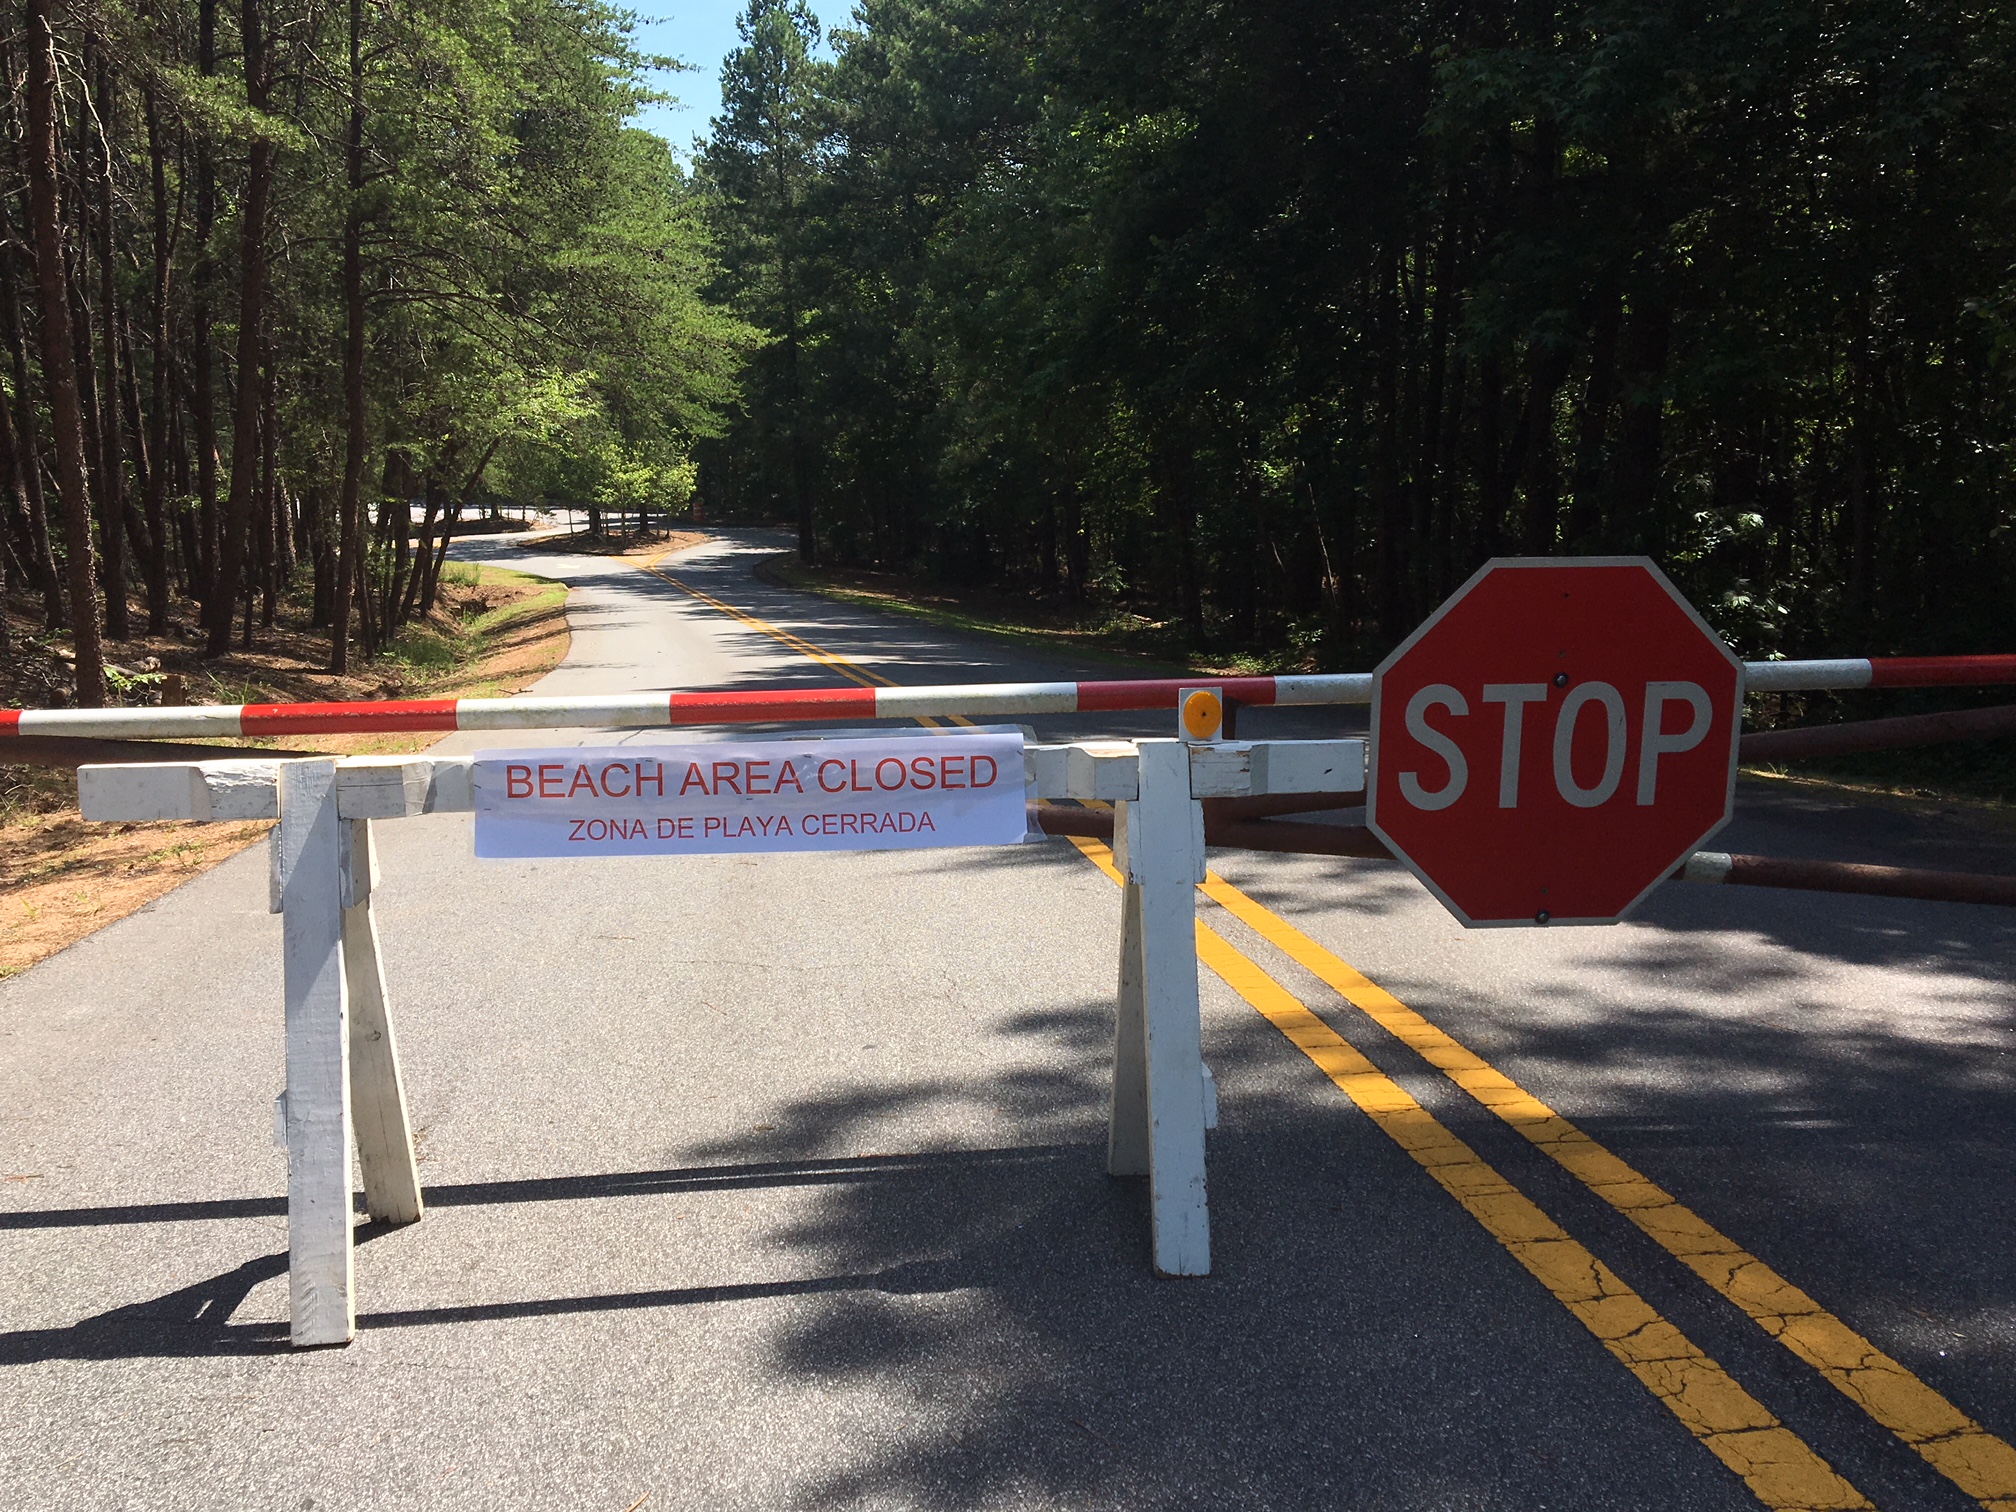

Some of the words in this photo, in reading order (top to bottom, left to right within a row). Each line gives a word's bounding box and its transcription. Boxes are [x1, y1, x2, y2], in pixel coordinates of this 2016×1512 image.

[1398, 681, 1713, 811] STOP
[506, 763, 664, 799] BEACH
[679, 761, 804, 796] AREA
[817, 755, 998, 793] CLOSED
[568, 818, 649, 842] ZONA
[657, 817, 694, 840] DE
[703, 815, 794, 839] PLAYA
[801, 811, 936, 837] CERRADA
